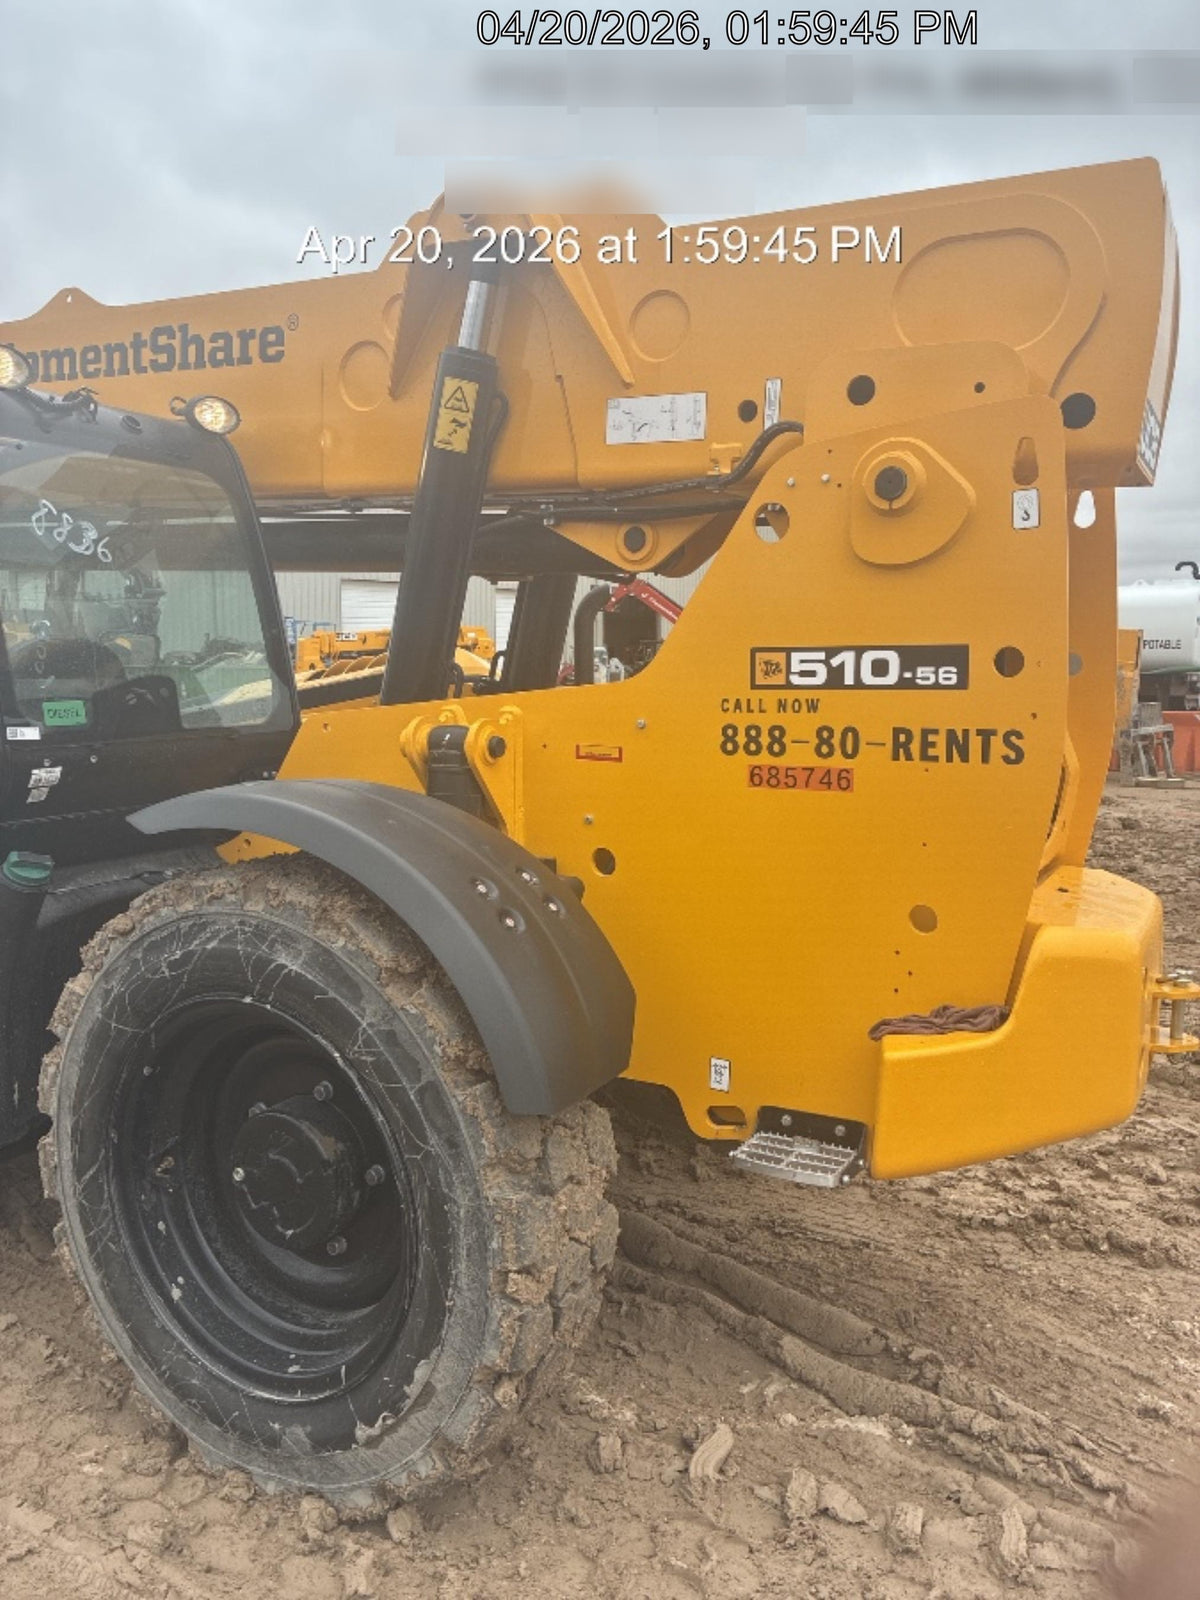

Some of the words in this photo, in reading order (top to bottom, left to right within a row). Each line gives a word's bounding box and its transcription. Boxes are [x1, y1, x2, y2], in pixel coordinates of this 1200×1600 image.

[1142, 639, 1182, 650] POTABLE
[789, 650, 958, 686] 510-56
[720, 698, 768, 714] CALL
[776, 698, 821, 714] NOW
[750, 766, 852, 791] 685746
